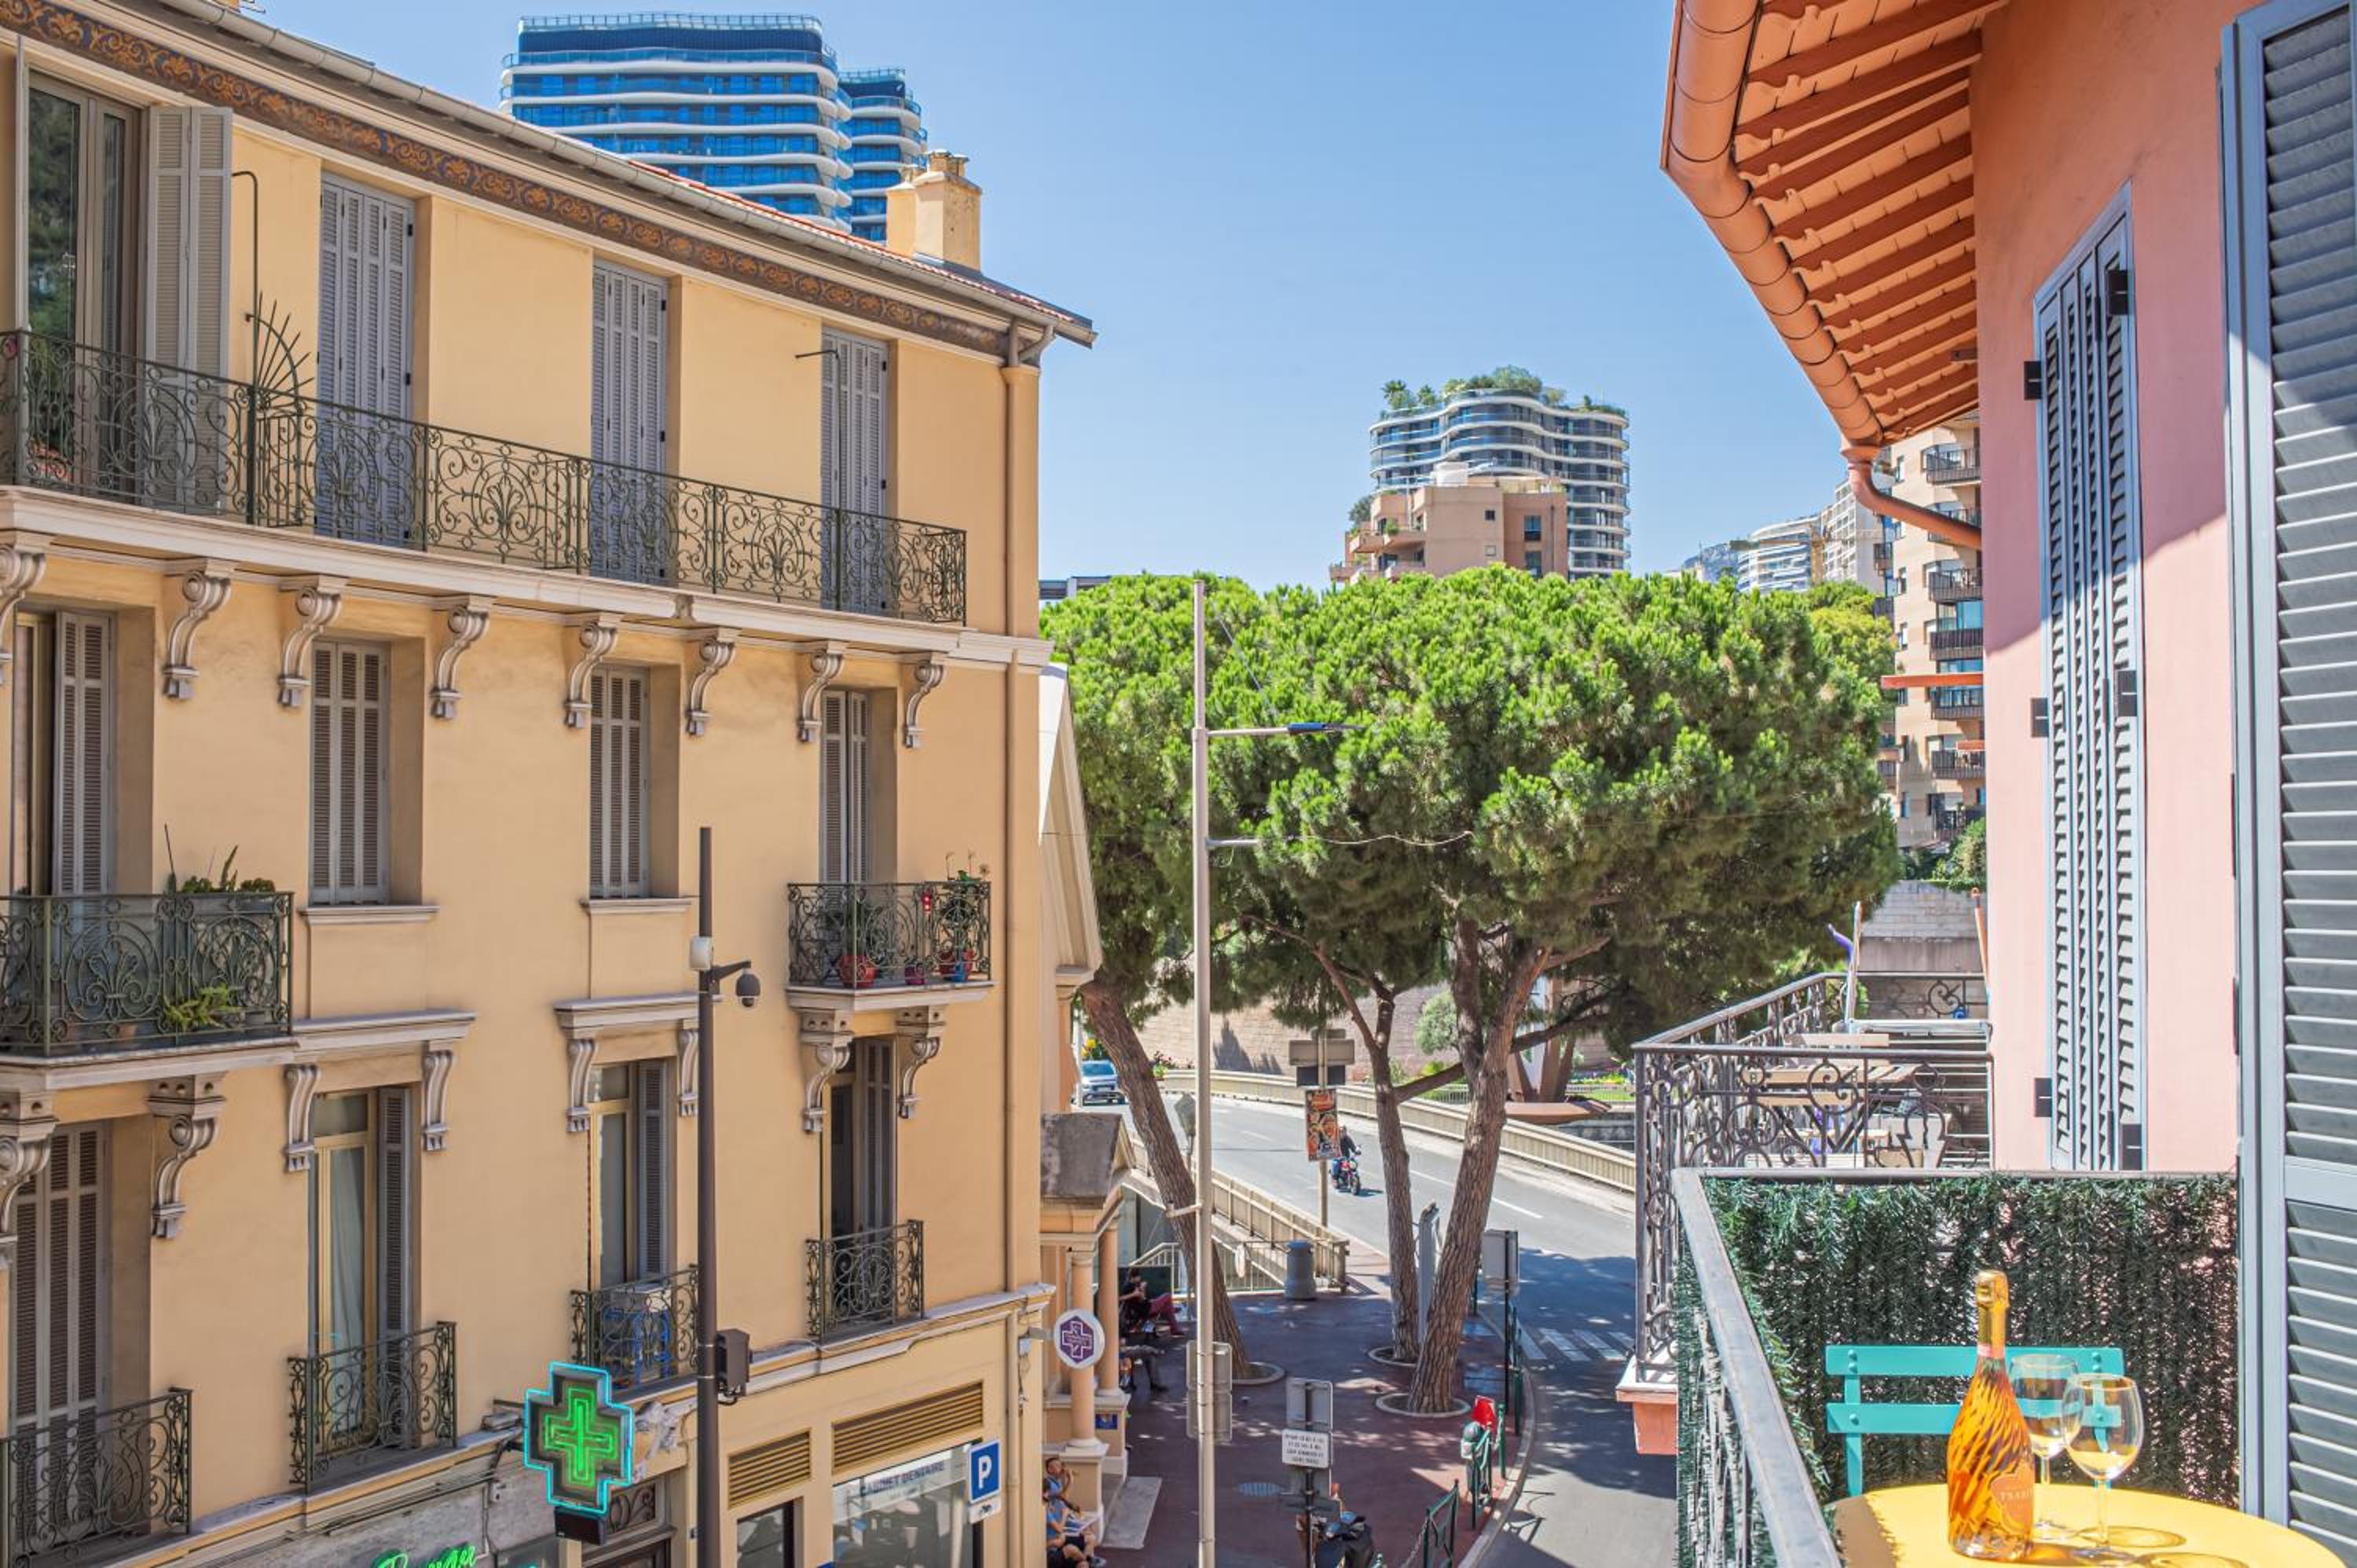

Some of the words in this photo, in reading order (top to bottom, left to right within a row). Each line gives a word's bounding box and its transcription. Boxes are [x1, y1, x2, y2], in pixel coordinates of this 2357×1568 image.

[860, 1474, 900, 1497] CABINET
[903, 1461, 944, 1482] DENTAIRE
[978, 1455, 992, 1489] P
